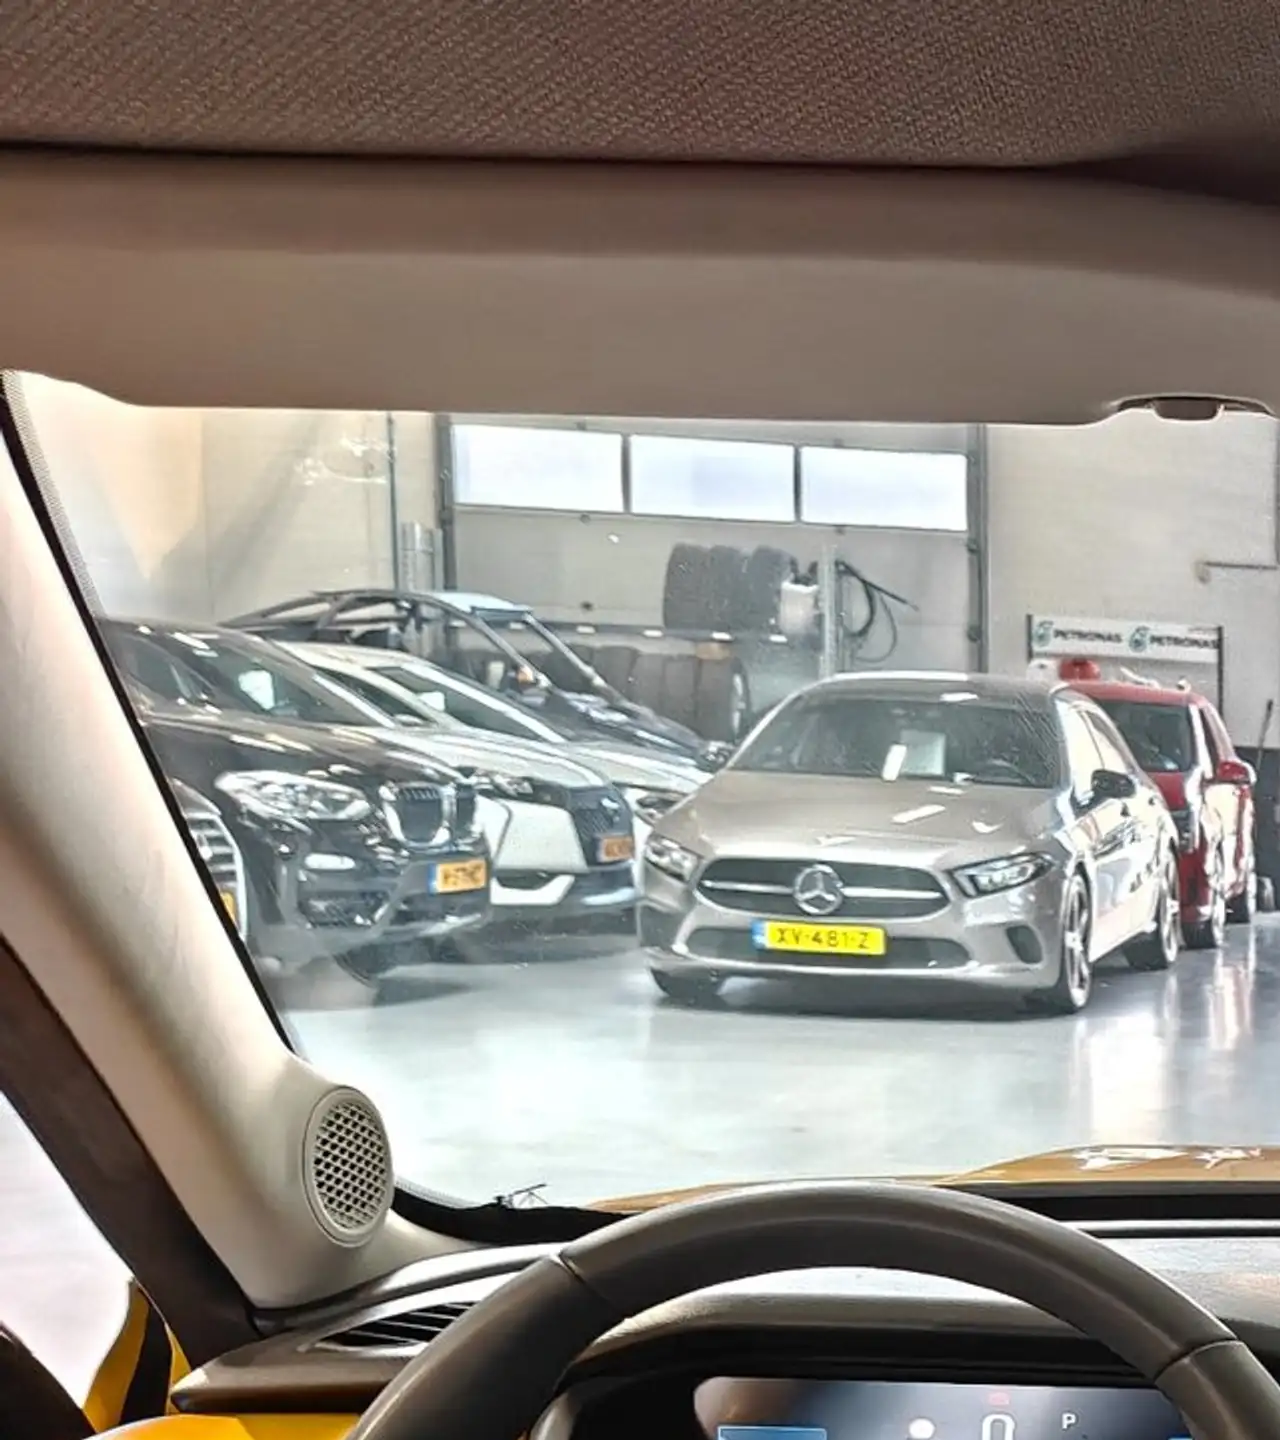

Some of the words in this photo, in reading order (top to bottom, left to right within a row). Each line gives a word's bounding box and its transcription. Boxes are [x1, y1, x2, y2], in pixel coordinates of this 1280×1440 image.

[1053, 629, 1123, 644] PETRONAS
[1150, 635, 1219, 650] PETRONAS
[777, 927, 869, 948] XV-481-Z
[1062, 1413, 1077, 1429] P
